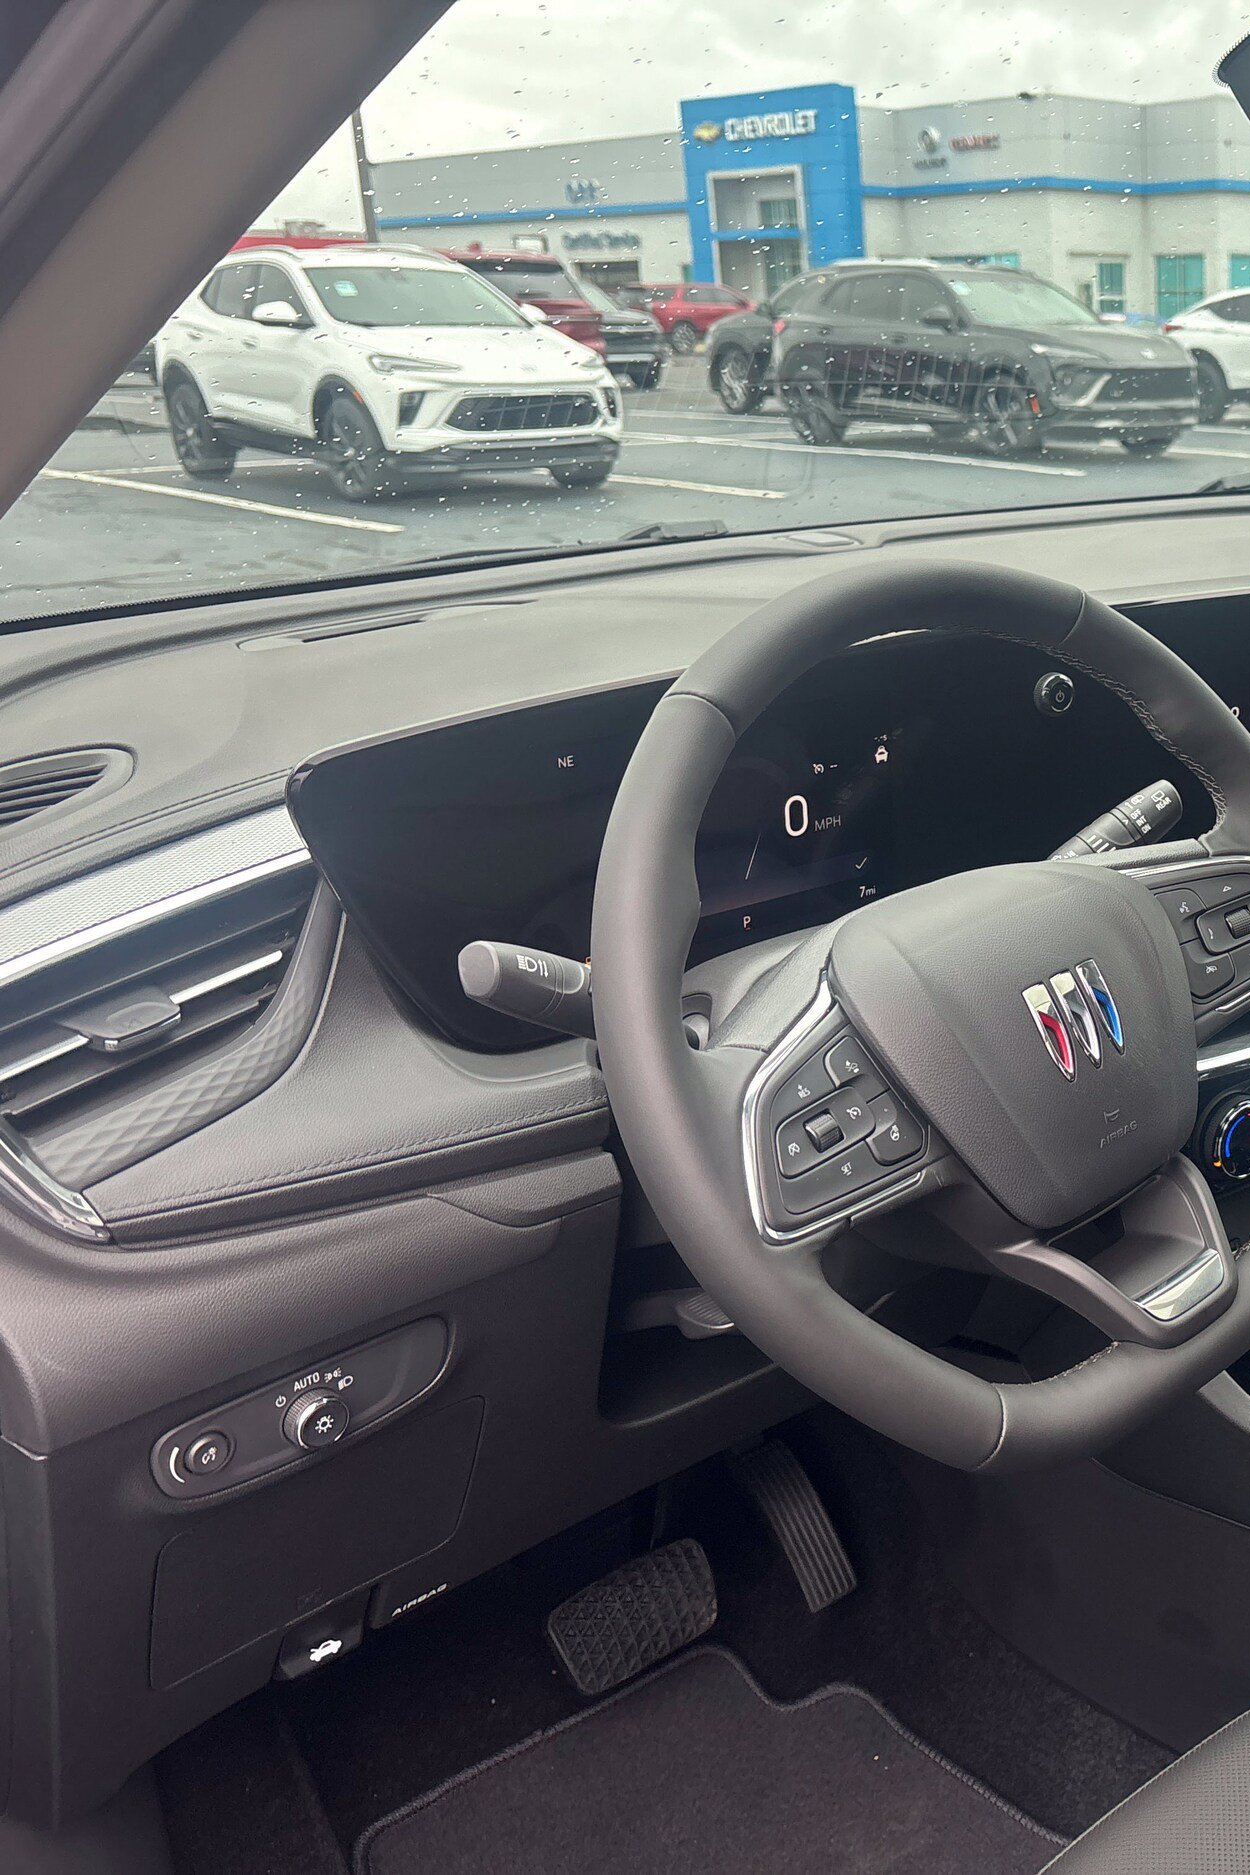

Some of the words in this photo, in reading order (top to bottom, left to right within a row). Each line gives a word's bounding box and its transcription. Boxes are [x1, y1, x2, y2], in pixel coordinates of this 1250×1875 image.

[724, 109, 818, 141] CHEVROLET
[557, 755, 575, 768] NE
[784, 795, 809, 837] 0
[814, 815, 841, 832] MPH
[743, 916, 751, 928] P
[798, 1086, 811, 1099] RES
[1100, 1120, 1138, 1149] AIRBAG
[293, 1371, 320, 1392] AUTO
